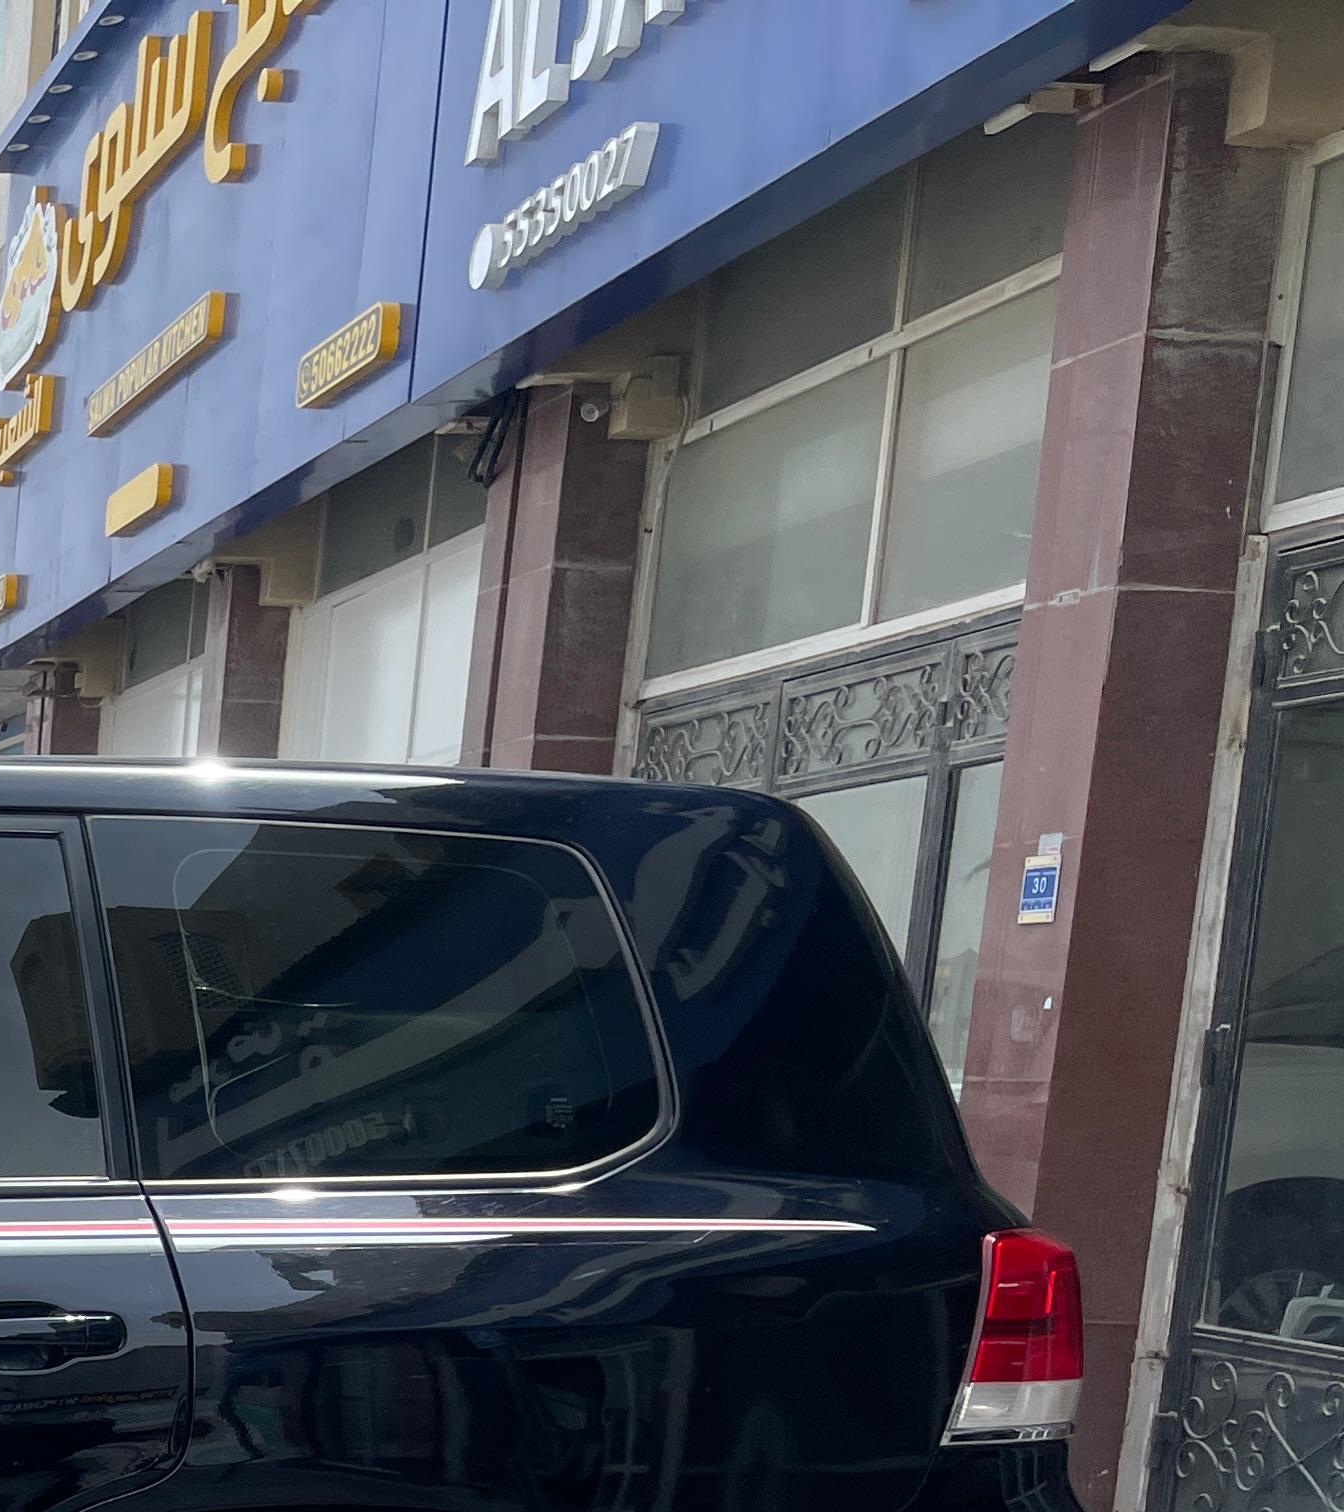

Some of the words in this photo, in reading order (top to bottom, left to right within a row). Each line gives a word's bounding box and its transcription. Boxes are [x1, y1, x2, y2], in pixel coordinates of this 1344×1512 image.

[498, 123, 644, 268] 55350027
[117, 339, 160, 405] POPULAR
[310, 313, 377, 392] 50662222
[1032, 876, 1047, 893] 30
